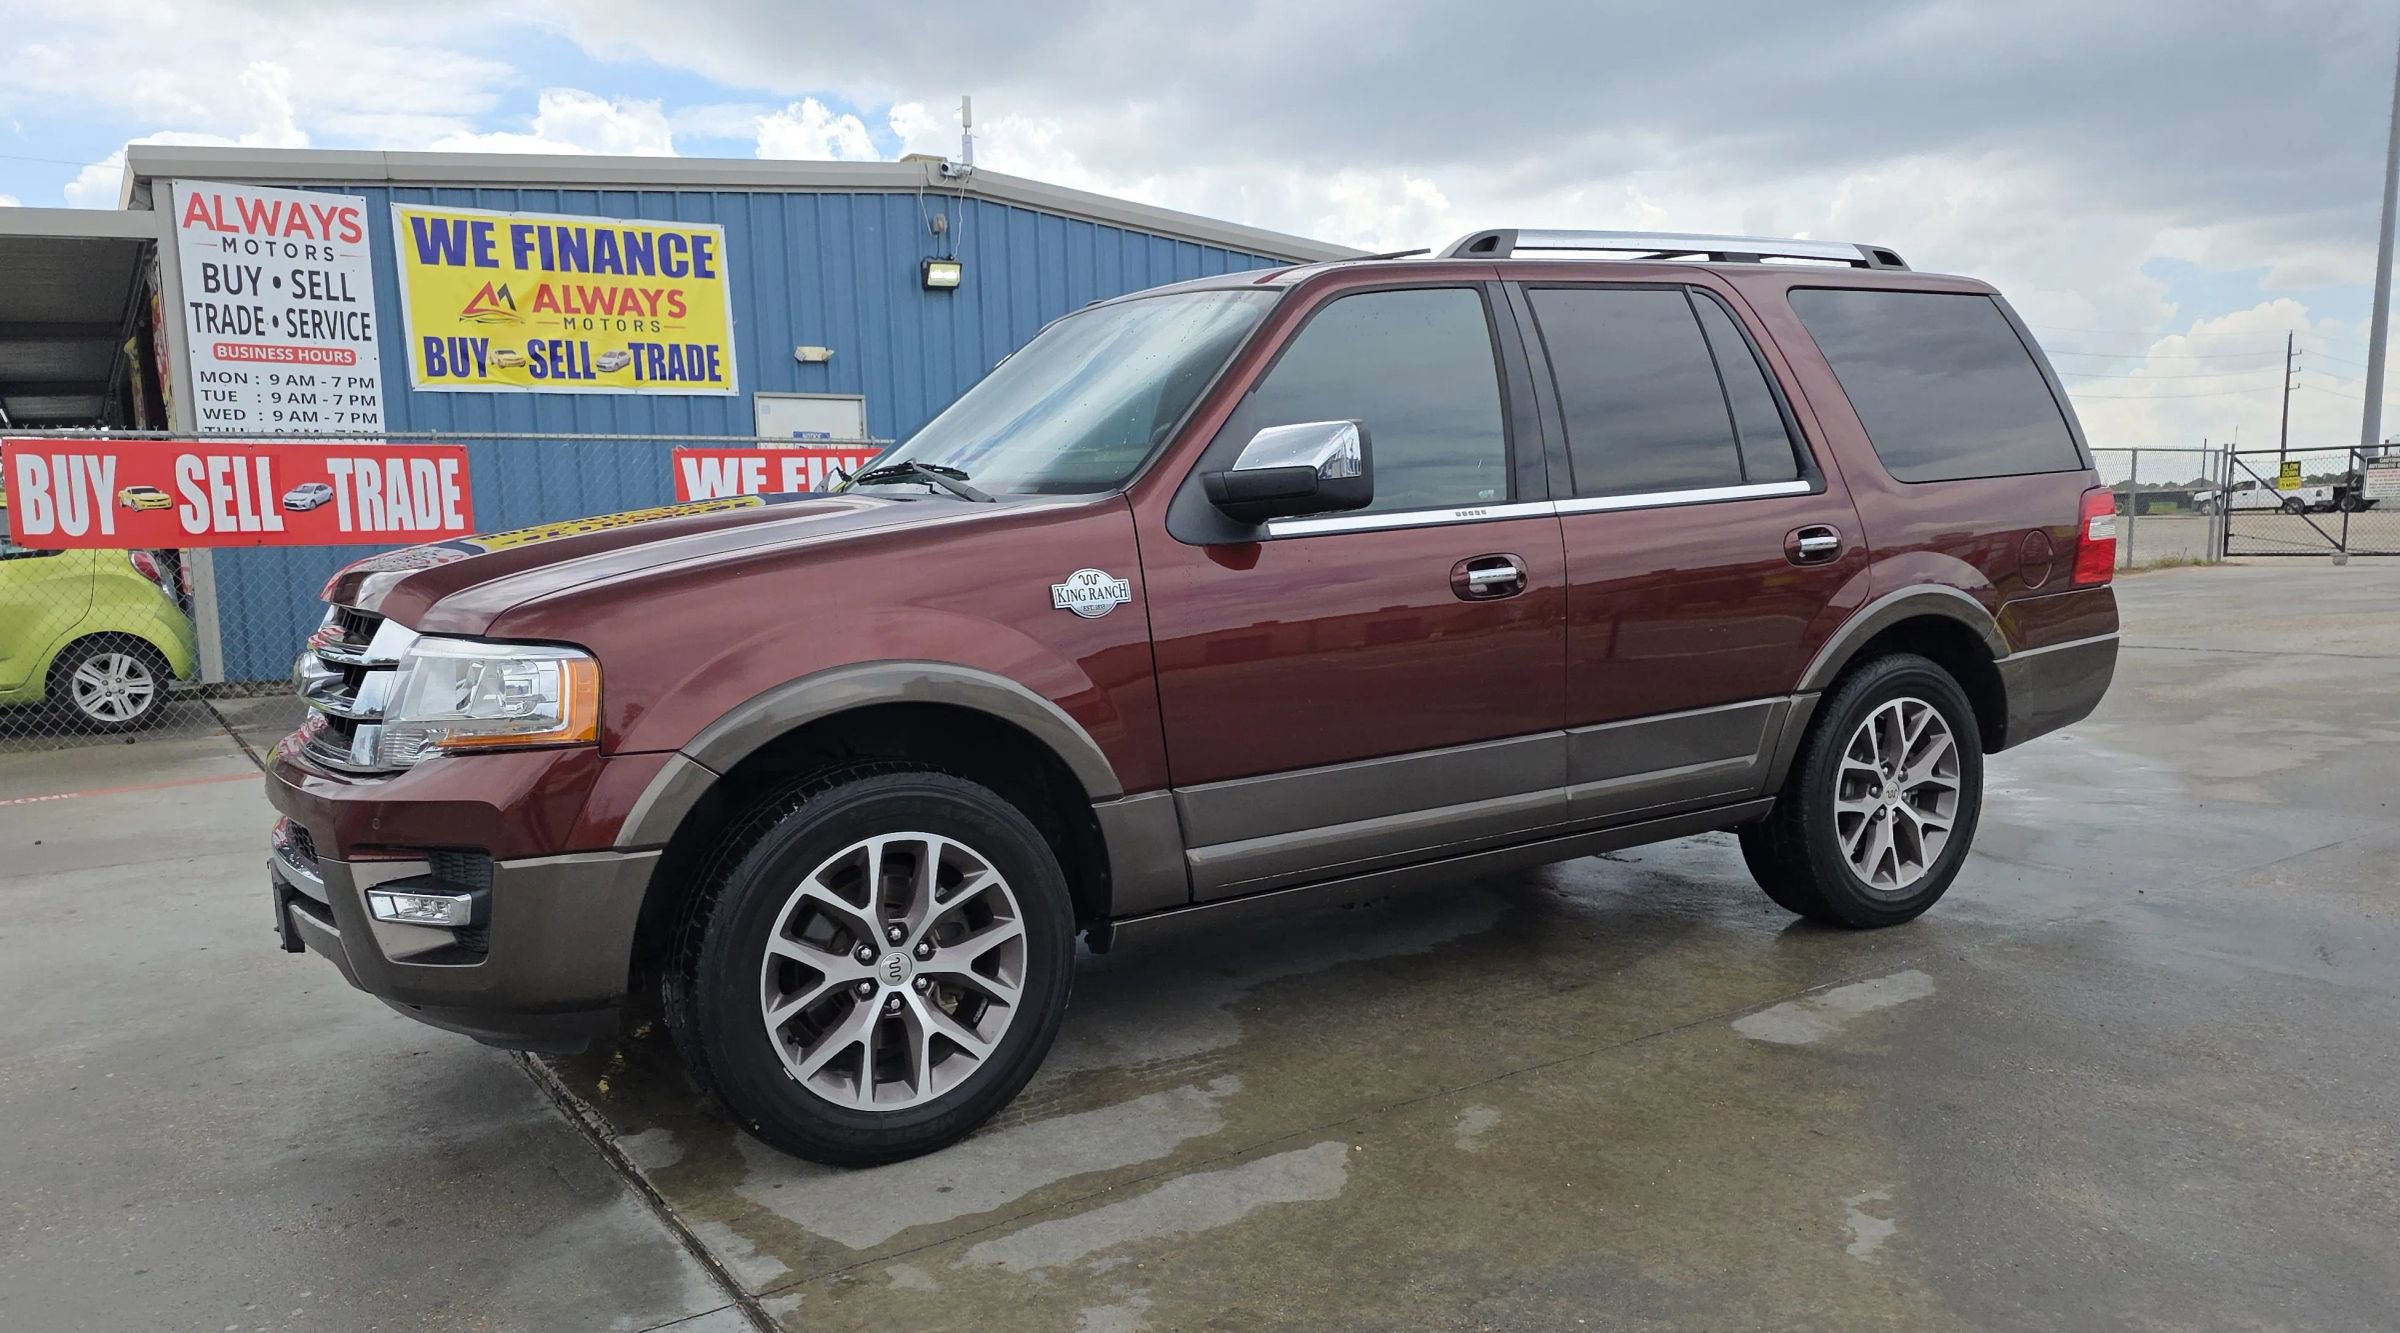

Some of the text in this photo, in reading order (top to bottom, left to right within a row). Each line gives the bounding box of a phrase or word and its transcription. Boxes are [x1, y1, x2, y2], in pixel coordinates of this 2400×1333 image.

[183, 192, 362, 244] ALWAYS
[222, 236, 335, 262] MOTORS
[410, 216, 716, 280] WE FINANCE
[202, 262, 356, 302] BUY SELL
[532, 283, 688, 319] ALWAYS
[189, 301, 372, 342] TRADE SERVICE
[563, 316, 661, 333] MOTORS
[217, 345, 352, 364] BUSINESS HOURS
[423, 336, 722, 382] BUY SELL TRADE
[200, 371, 248, 384] MON
[269, 374, 280, 386] 9
[285, 374, 315, 387] AM
[331, 376, 342, 388] 7
[348, 377, 375, 389] PM
[200, 389, 238, 402] TUE
[271, 392, 282, 404] 9
[287, 392, 317, 405] AM
[332, 394, 344, 406] 7
[349, 395, 376, 407] PM
[202, 408, 246, 421] WED
[273, 410, 283, 422] 9
[289, 410, 318, 422] AM
[334, 412, 345, 423] 7
[351, 412, 378, 424] PM
[15, 453, 117, 536] BUY
[174, 453, 284, 535] SELL
[326, 457, 465, 532] TRADE
[681, 457, 873, 500] WE FIN
[1056, 582, 1128, 603] KING RANCH
